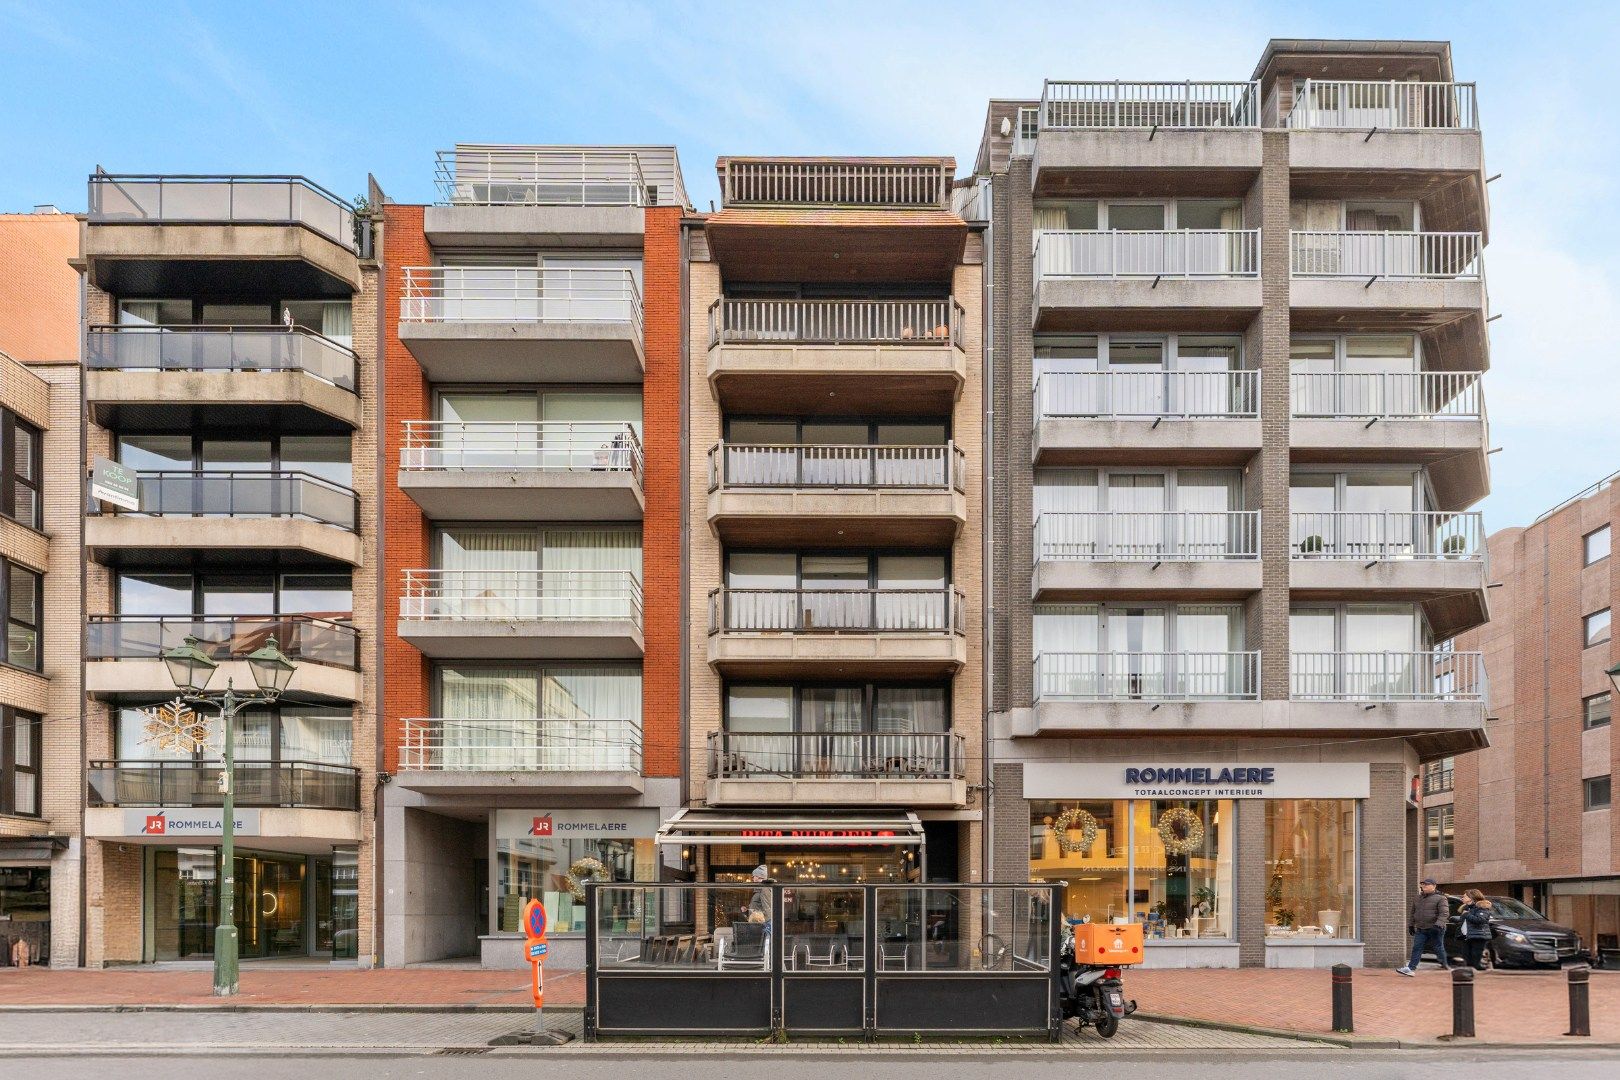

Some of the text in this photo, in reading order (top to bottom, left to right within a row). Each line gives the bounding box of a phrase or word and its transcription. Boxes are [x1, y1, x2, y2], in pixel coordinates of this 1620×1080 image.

[112, 465, 124, 475] TE
[103, 469, 132, 484] KOOP
[1125, 767, 1275, 784] ROMMELAERE
[149, 820, 243, 830] JR ROMMELAE
[536, 822, 627, 831] JR ROMMELAERE
